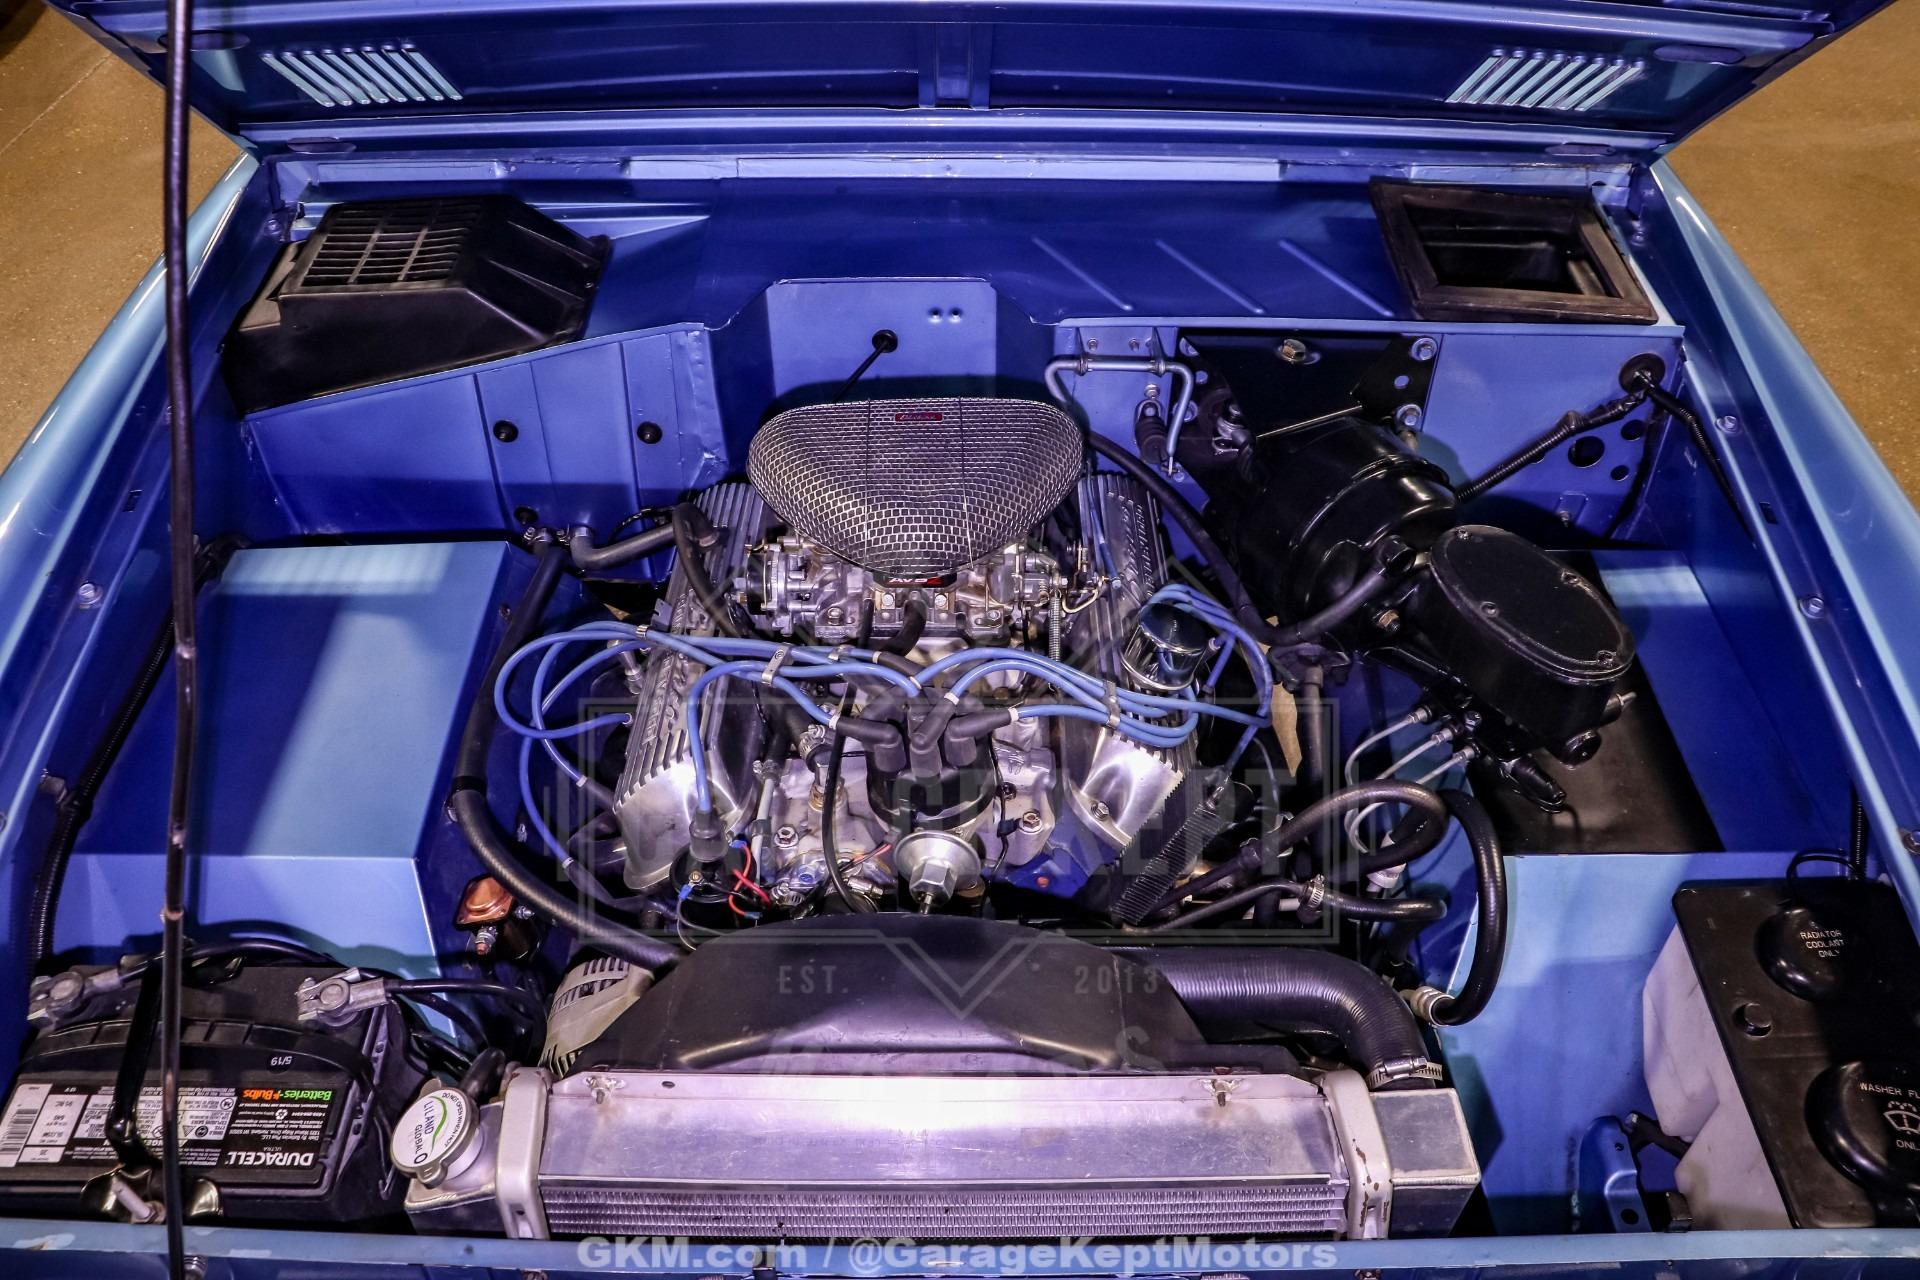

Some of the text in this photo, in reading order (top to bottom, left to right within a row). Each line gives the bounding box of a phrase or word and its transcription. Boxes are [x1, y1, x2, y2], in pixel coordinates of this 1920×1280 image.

[1800, 930, 1842, 940] RADIATOR
[1806, 939, 1845, 949] COOLANT
[270, 1056, 293, 1066] 5/19
[1860, 1082, 1902, 1096] WASHER
[423, 1100, 435, 1135] LILAND
[414, 1124, 423, 1155] GLOBAL
[1896, 1139, 1920, 1151] ONL
[227, 1152, 314, 1167] DURACELL
